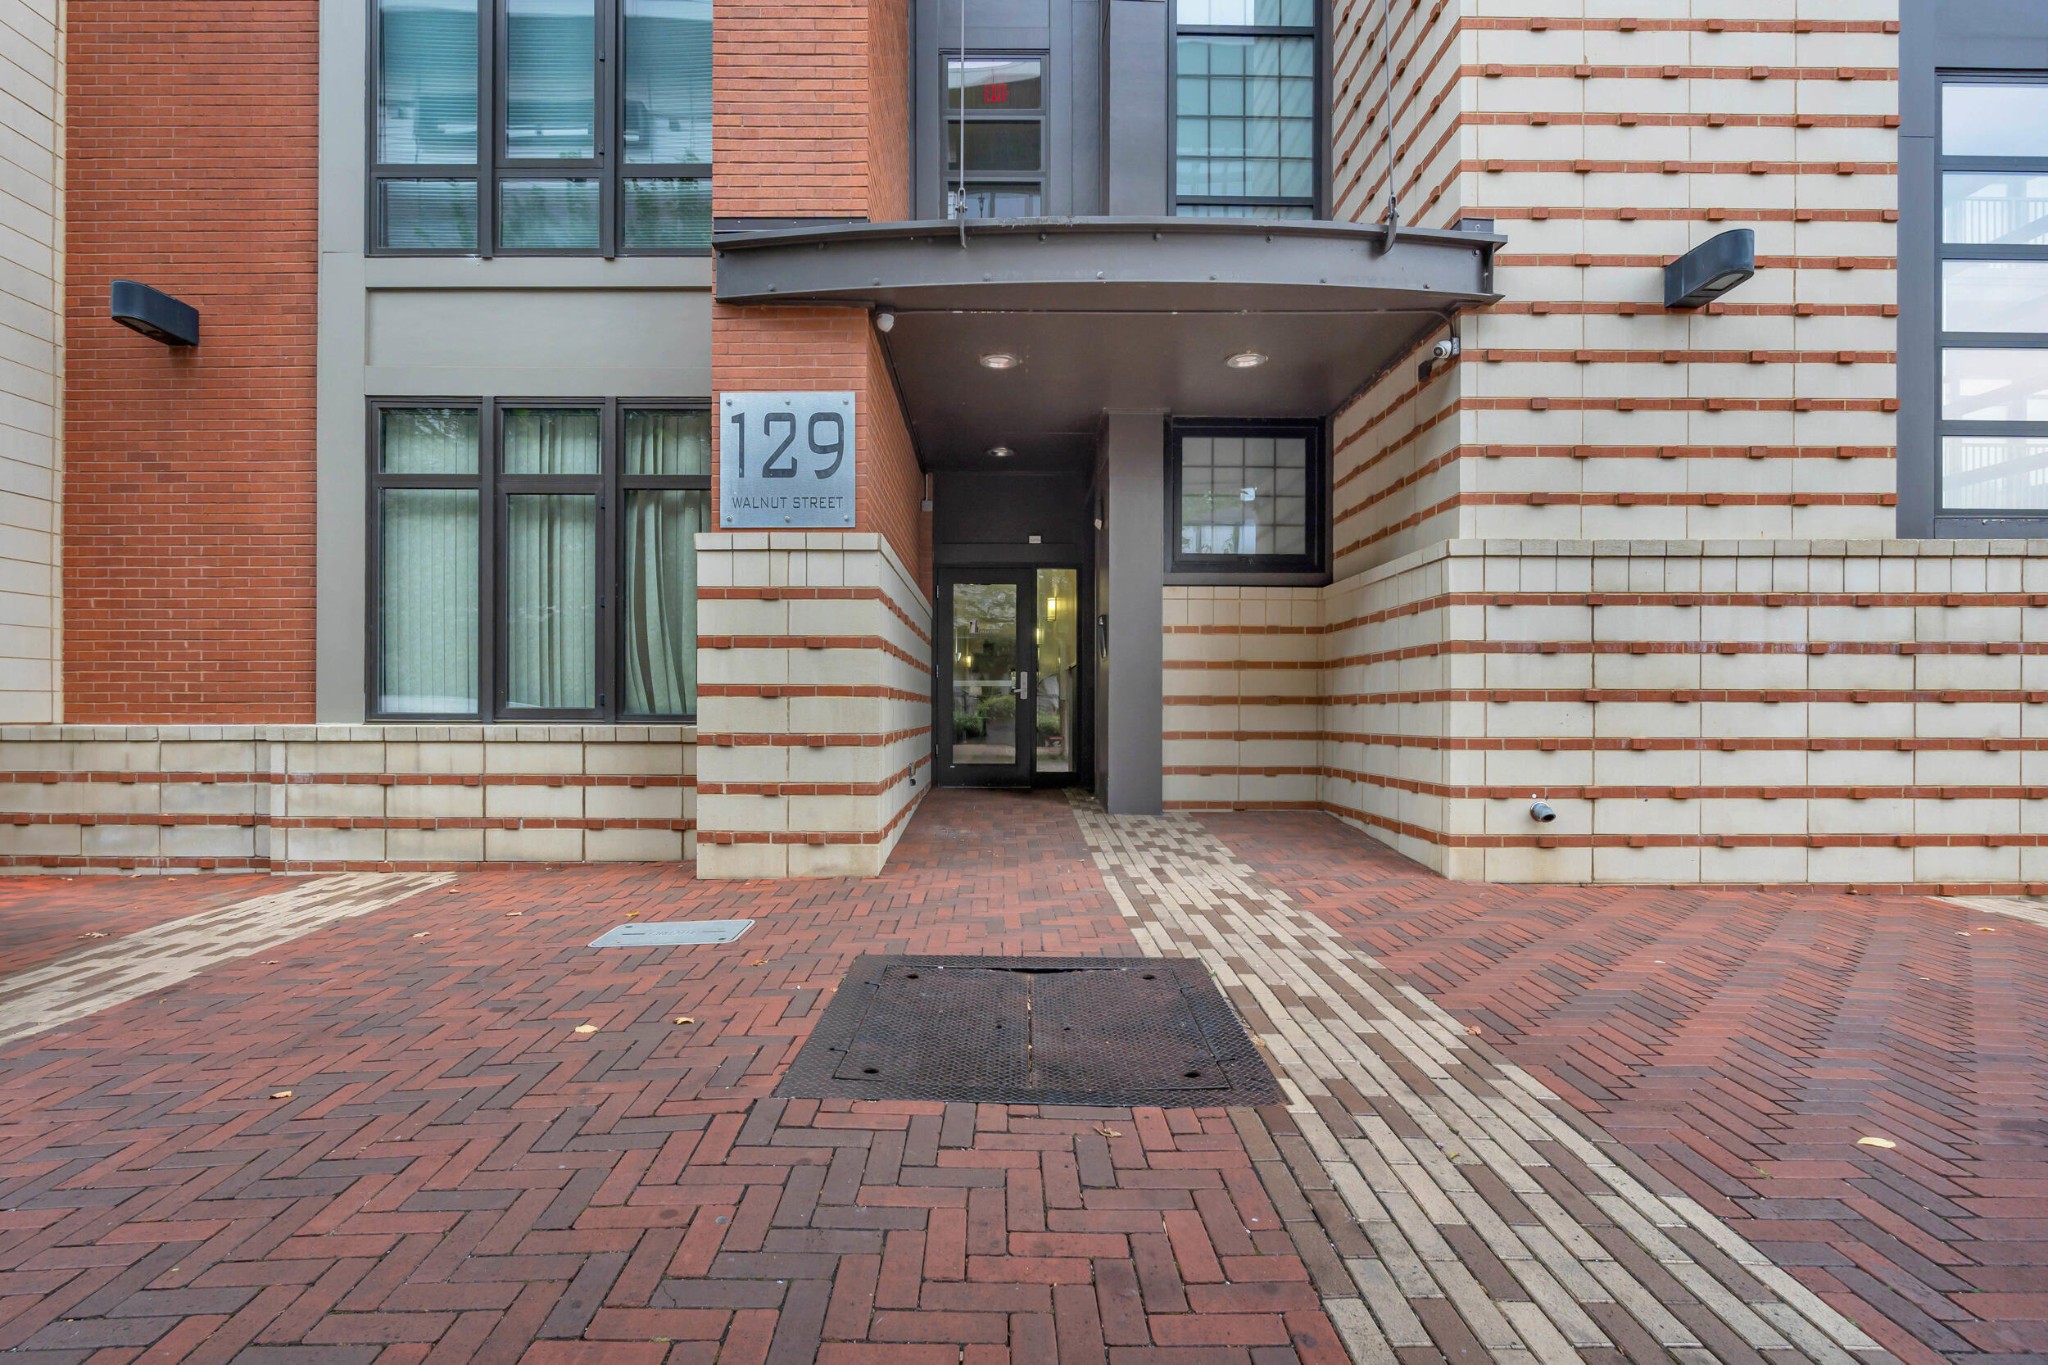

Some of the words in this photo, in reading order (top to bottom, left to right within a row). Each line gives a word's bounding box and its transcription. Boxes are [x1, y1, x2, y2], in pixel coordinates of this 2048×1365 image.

[731, 411, 845, 480] 129
[732, 496, 787, 509] WALNUT
[792, 496, 844, 509] STREET
